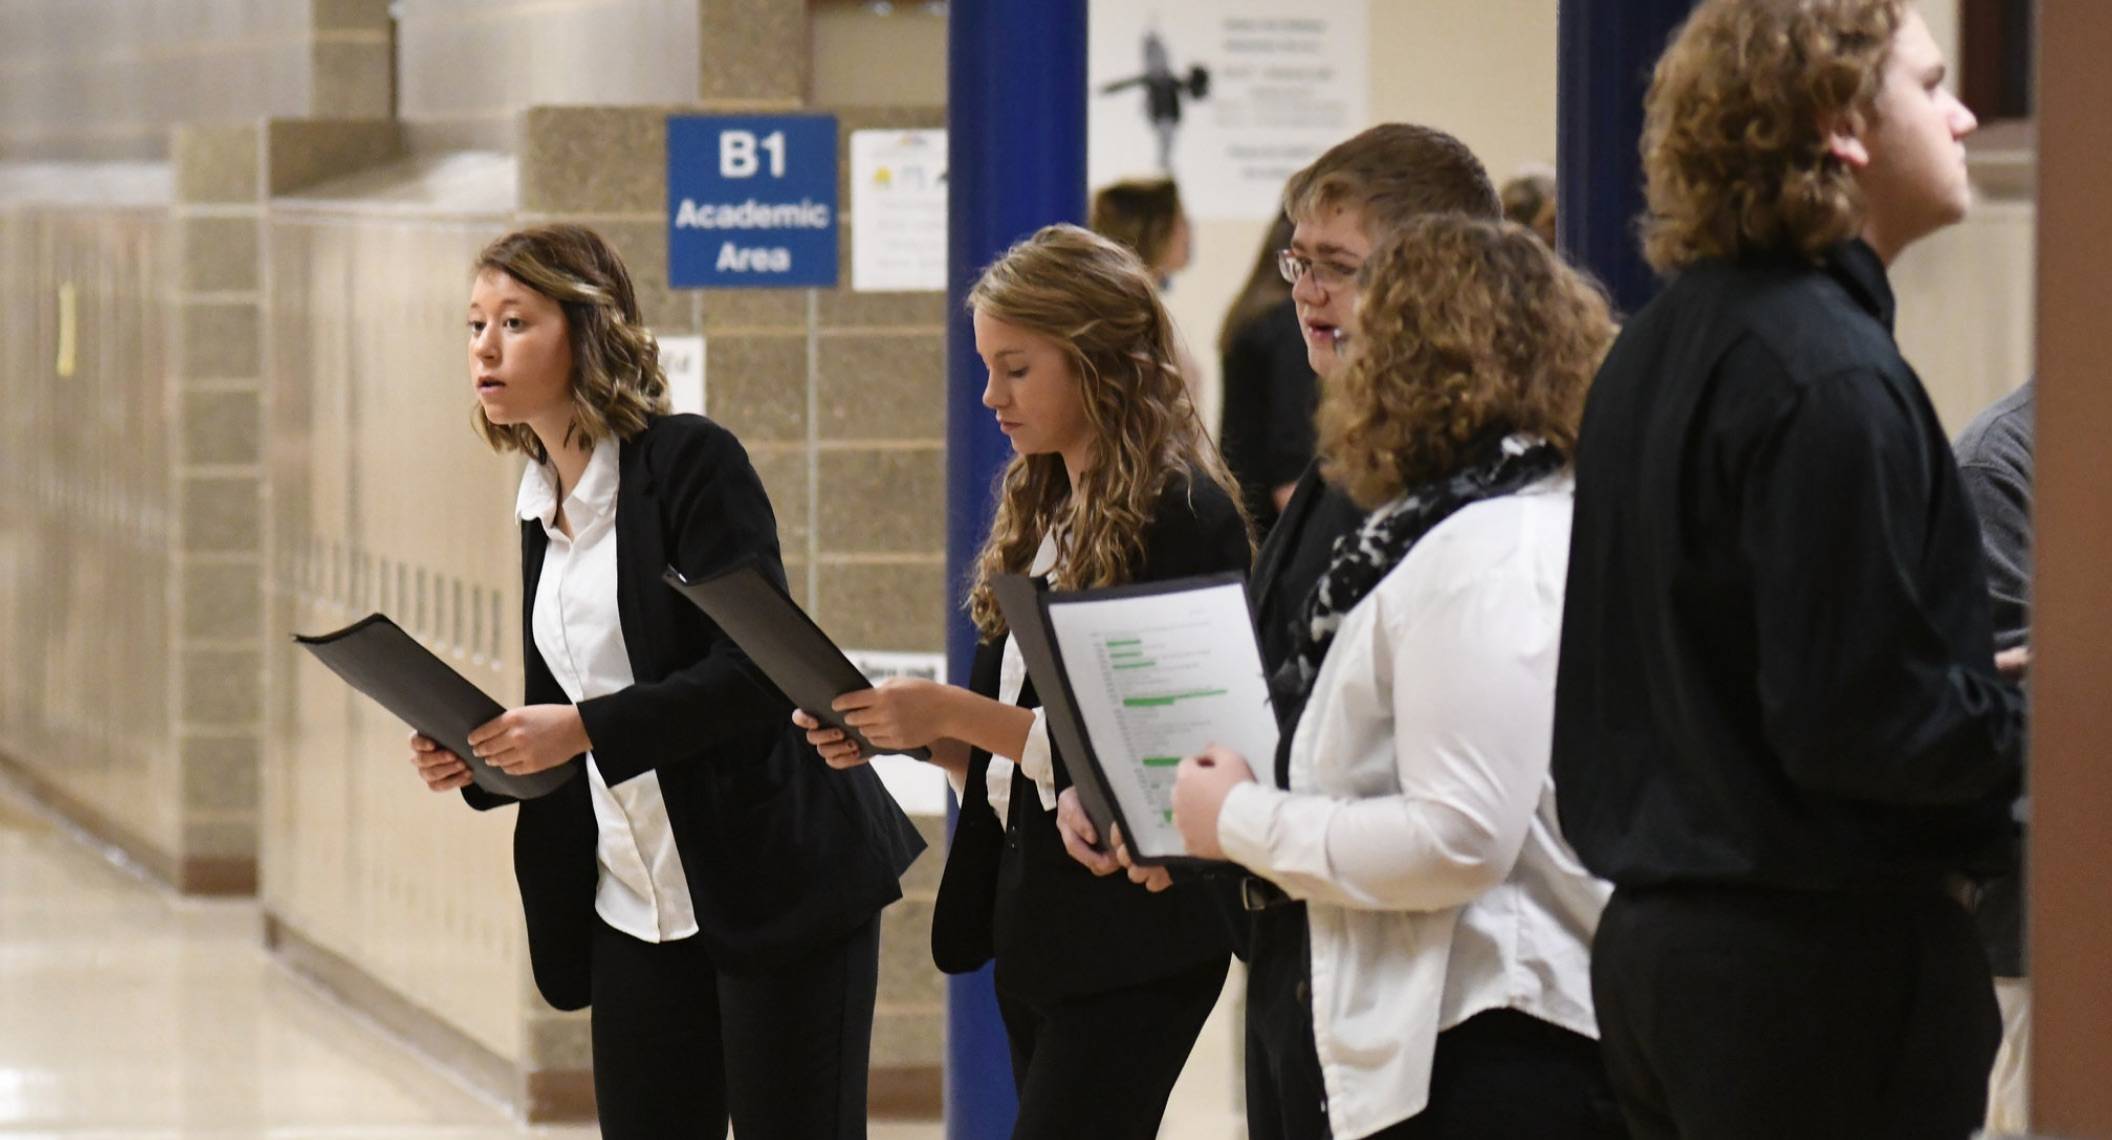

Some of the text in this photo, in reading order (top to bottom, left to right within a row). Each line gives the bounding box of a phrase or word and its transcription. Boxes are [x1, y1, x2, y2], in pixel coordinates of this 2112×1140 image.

[719, 130, 786, 178] B1
[675, 198, 829, 229] Academic
[715, 242, 791, 272] Area
